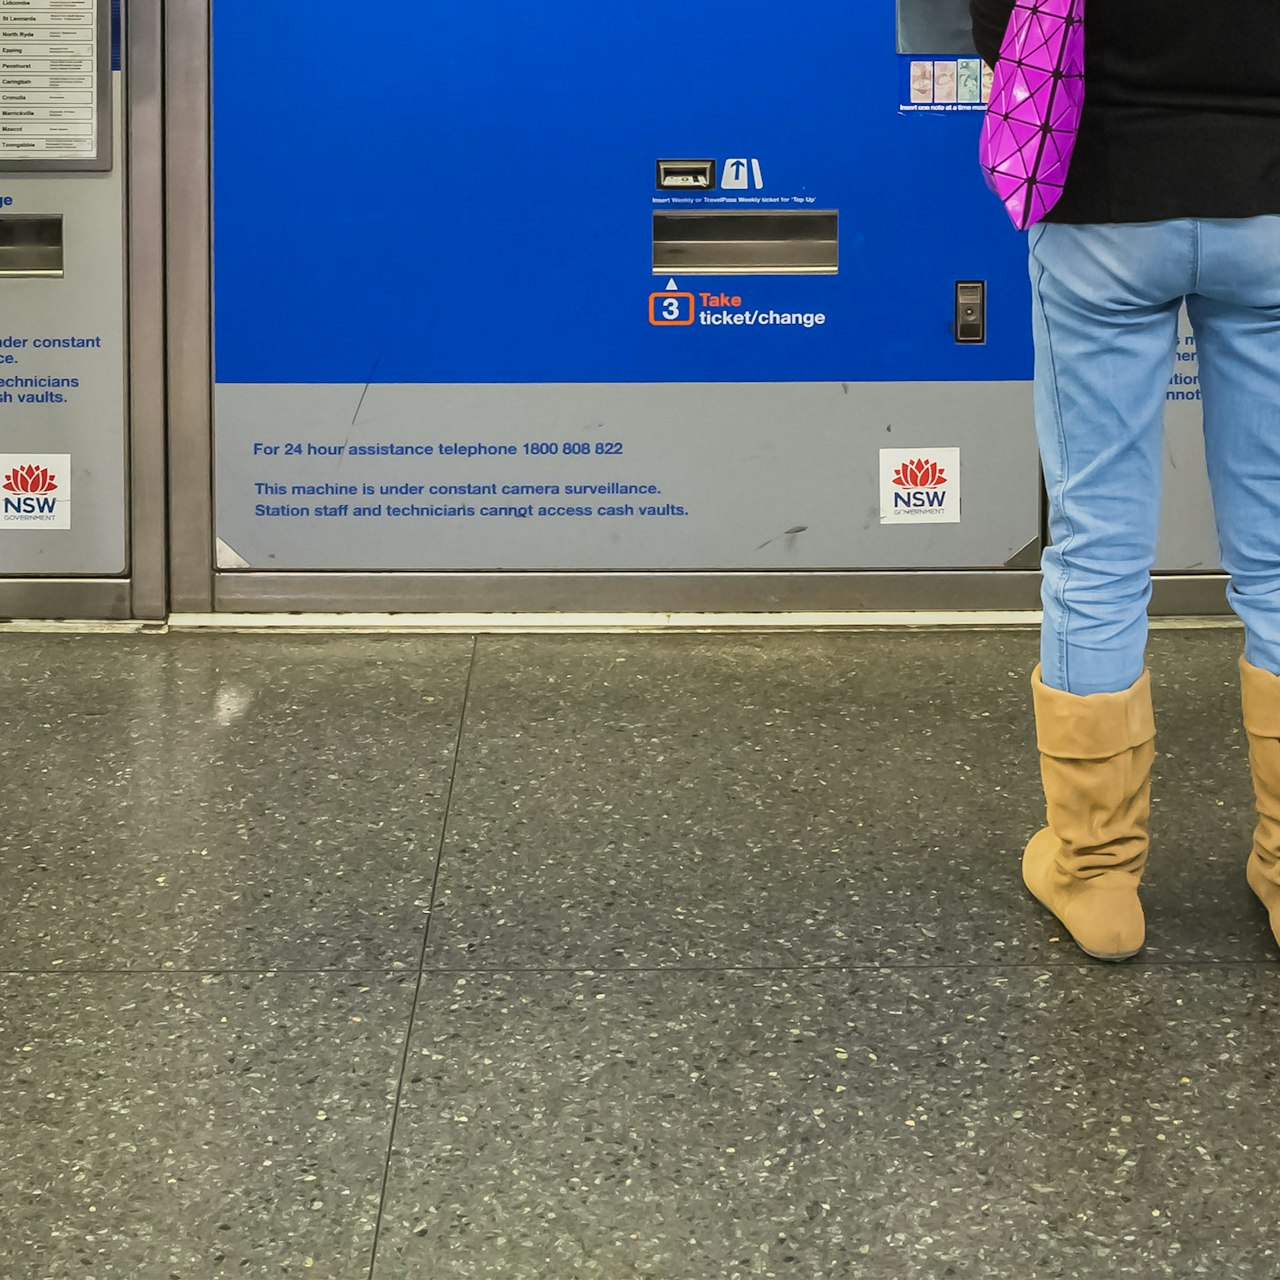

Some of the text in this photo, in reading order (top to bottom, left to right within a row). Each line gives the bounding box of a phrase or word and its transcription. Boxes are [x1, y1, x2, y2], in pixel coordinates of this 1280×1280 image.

[699, 292, 742, 308] Take
[662, 298, 680, 321] 3
[699, 310, 826, 328] ticket/change
[32, 336, 102, 348] constant
[17, 391, 68, 404] vaults.
[253, 442, 623, 457] For 24 hour assistance telephone 1800 808 822
[254, 482, 662, 495] This machine is under constant camera surveillance.
[4, 497, 57, 514] NSW
[893, 490, 947, 508] NSW
[255, 504, 689, 517] Station staff and technicians cannot access cash vaults.
[893, 508, 945, 516] GOVERNMENT
